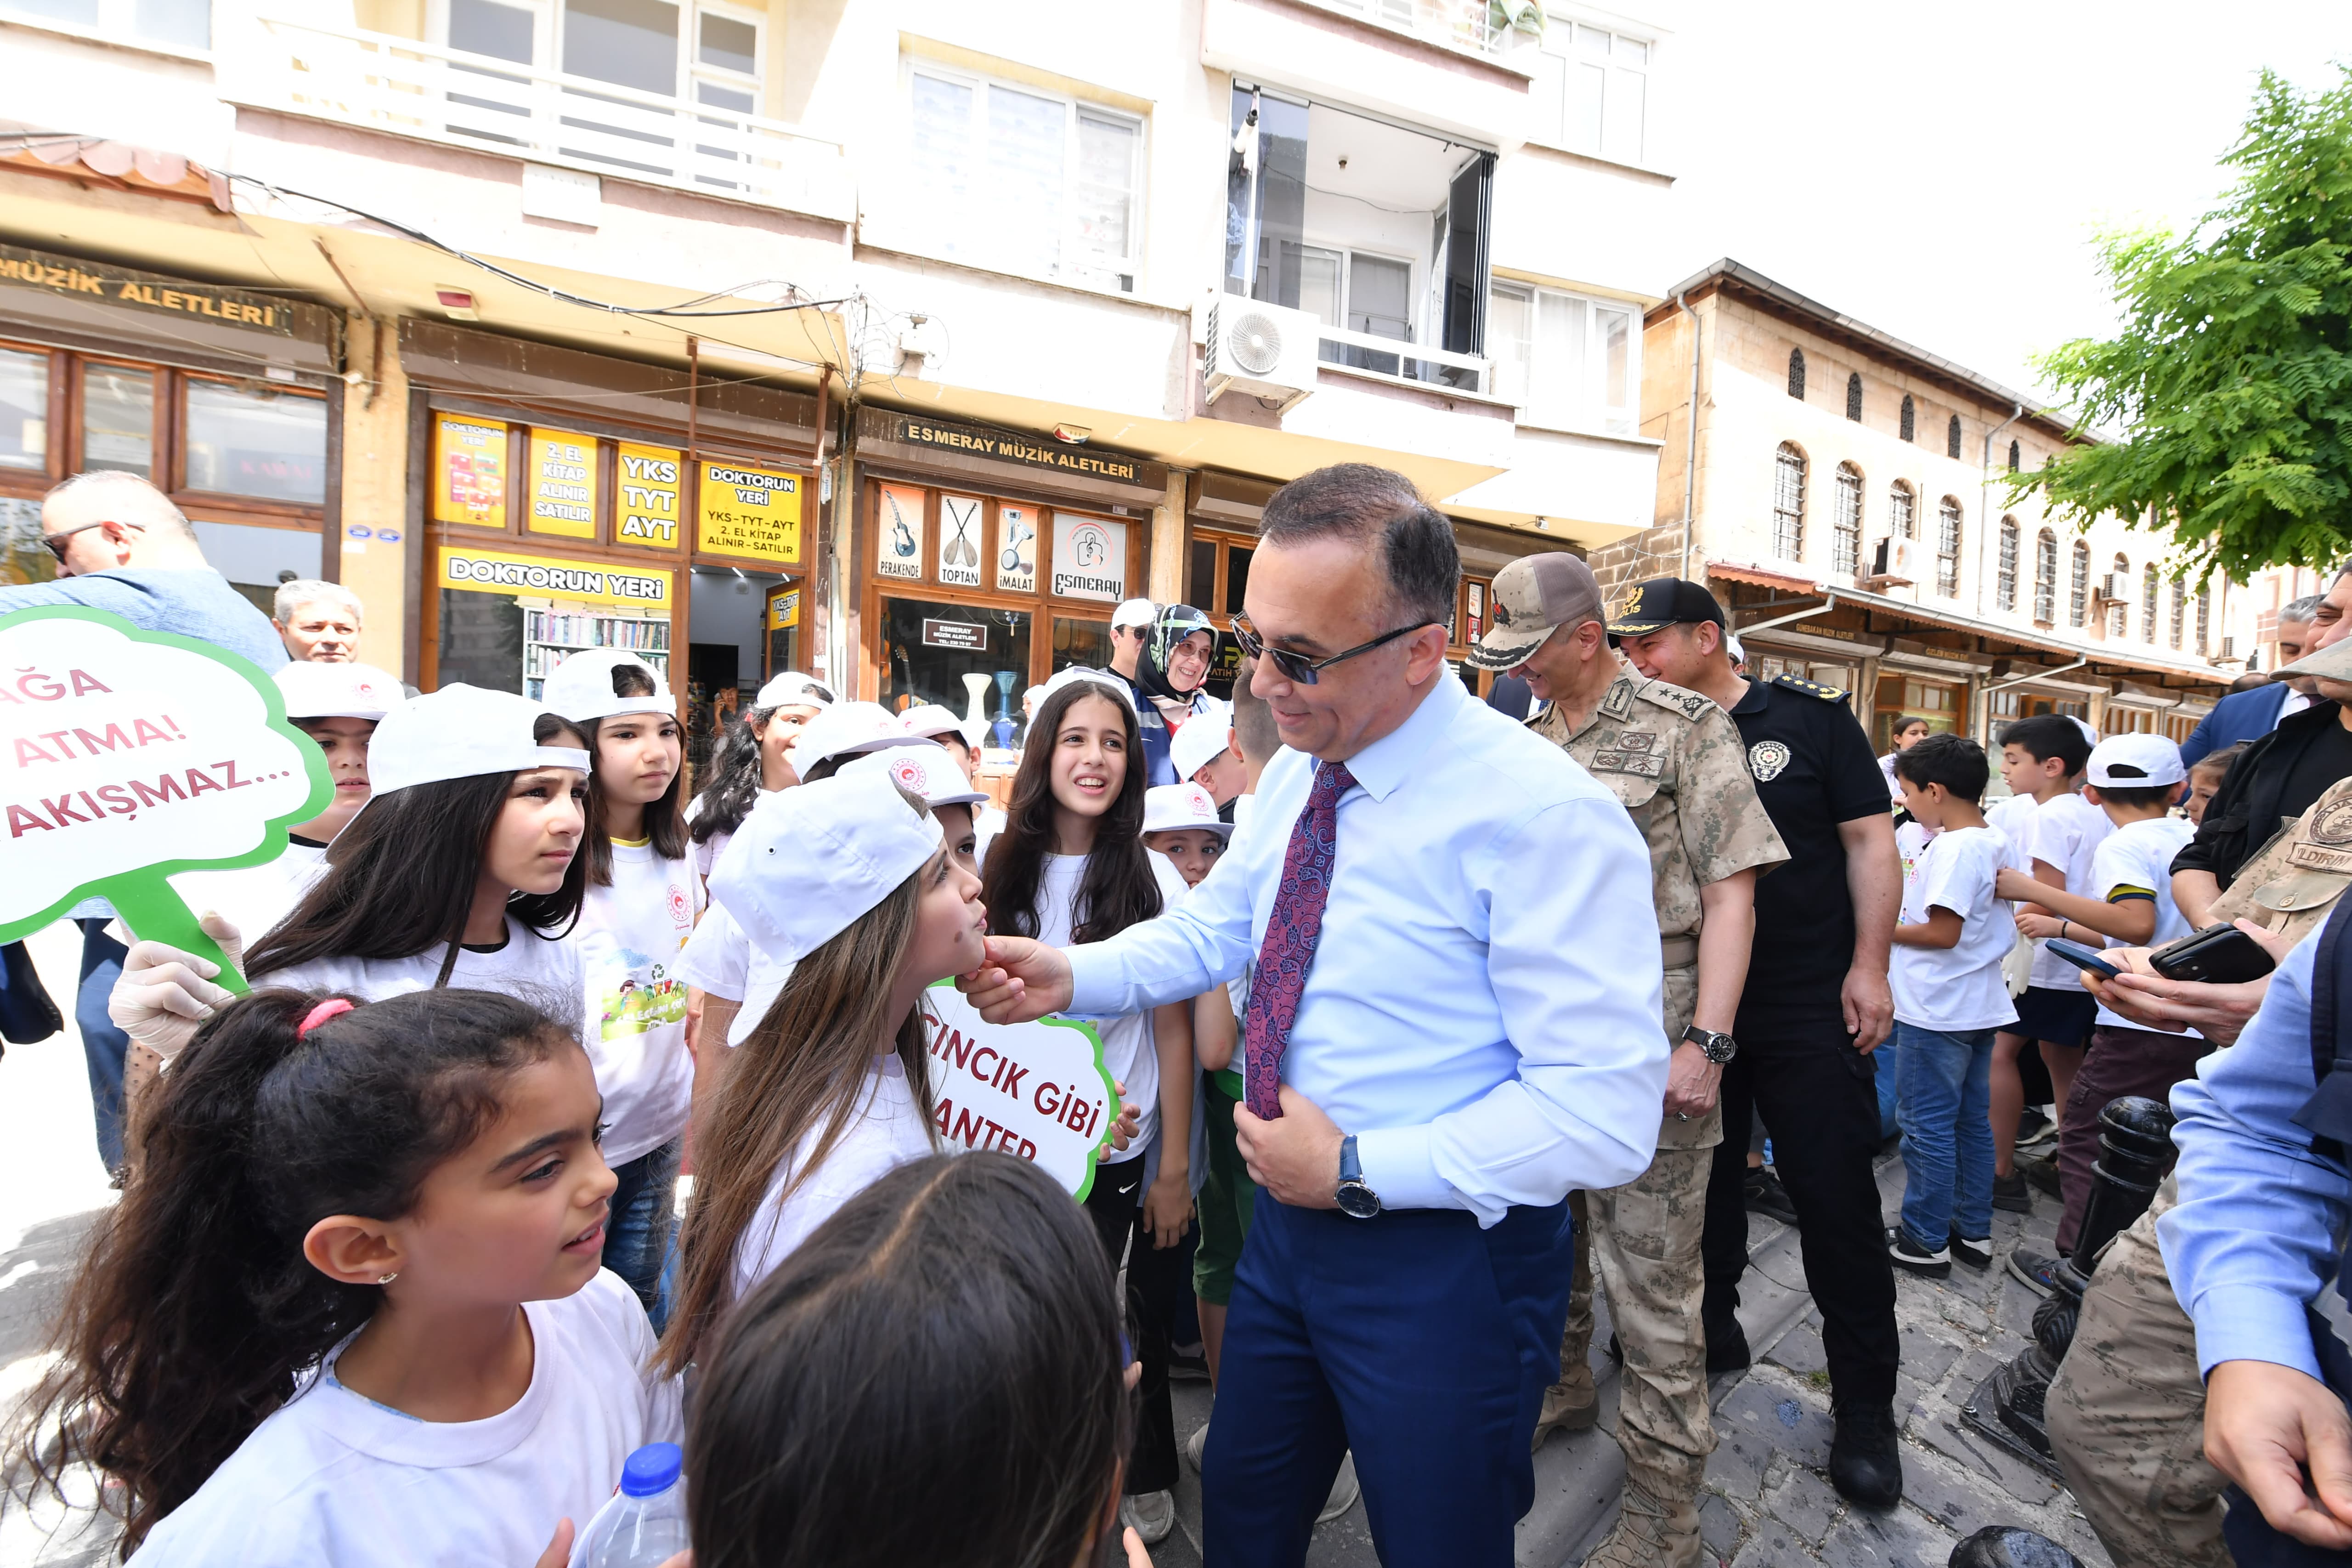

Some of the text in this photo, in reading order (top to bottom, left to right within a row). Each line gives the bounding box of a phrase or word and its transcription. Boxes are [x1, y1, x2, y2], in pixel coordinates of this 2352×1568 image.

[0, 259, 274, 327] MÜZİK ALETLERİ
[441, 420, 503, 438] DOKTORUN
[547, 443, 582, 462] 2. EL
[908, 425, 1134, 479] ESMERAY MÜZİK ALETLERİ
[542, 461, 587, 481] KİTAP
[622, 456, 677, 483] YKS
[710, 467, 795, 492] DOKTORUN
[538, 482, 588, 502] ALINIR
[623, 485, 675, 512] TYT
[735, 488, 769, 506] YERİ
[535, 501, 591, 522] SATILIR
[622, 515, 676, 540] AYT
[721, 526, 781, 541] 2. EL KİTAP
[449, 558, 663, 599] DOKTORUN YERİ
[881, 561, 919, 577] PERAKENDE
[942, 569, 978, 584] TOPTAN
[1055, 573, 1121, 601] ESMERAY
[779, 607, 790, 622] AYT
[939, 626, 972, 635] ESMERAY
[1208, 668, 1232, 677] ATİH
[13, 715, 187, 768] ATMA!
[6, 759, 290, 838] AKIŞMAZ...
[1034, 1084, 1102, 1138] GİBİ
